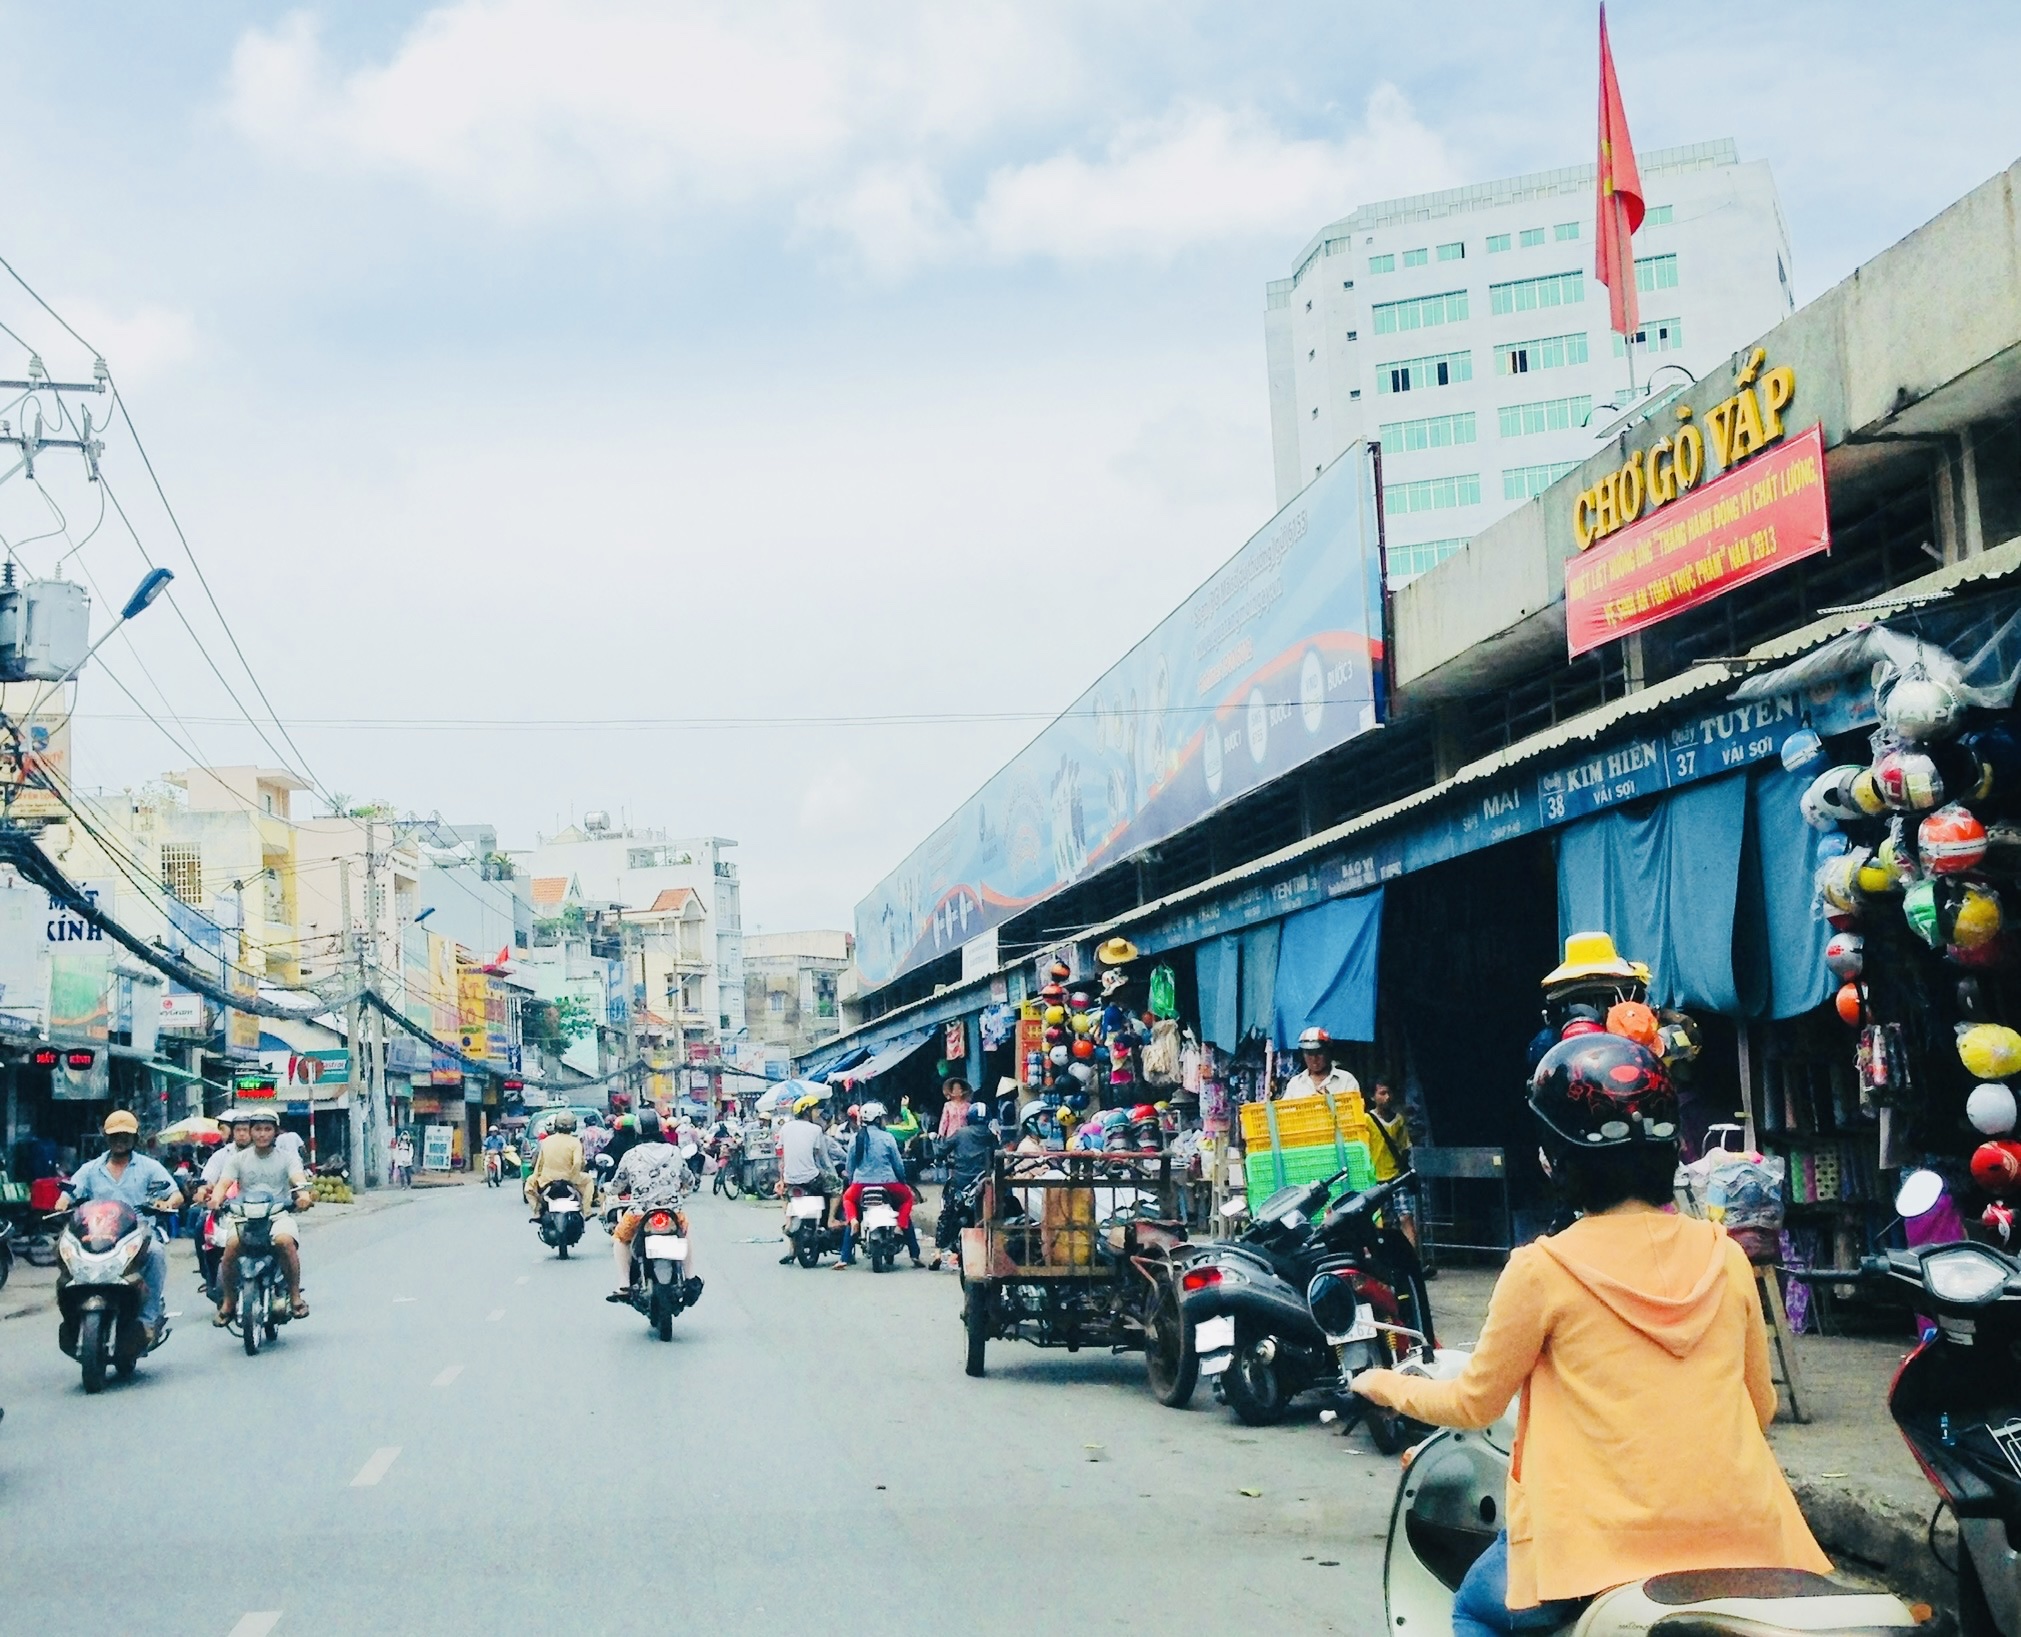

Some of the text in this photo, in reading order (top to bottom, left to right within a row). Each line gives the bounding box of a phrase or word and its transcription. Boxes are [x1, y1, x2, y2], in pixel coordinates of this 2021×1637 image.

[1704, 346, 1795, 470] VẤP
[1753, 466, 1778, 511] CHẤT
[1751, 525, 1778, 561] 2013
[1675, 751, 1696, 777] 37
[1721, 736, 1773, 766] VẢI SỢI
[1566, 760, 1604, 792] KIM
[1483, 787, 1520, 821] MAI
[1547, 792, 1565, 820] 38
[1593, 780, 1636, 805] VẢI SỢI
